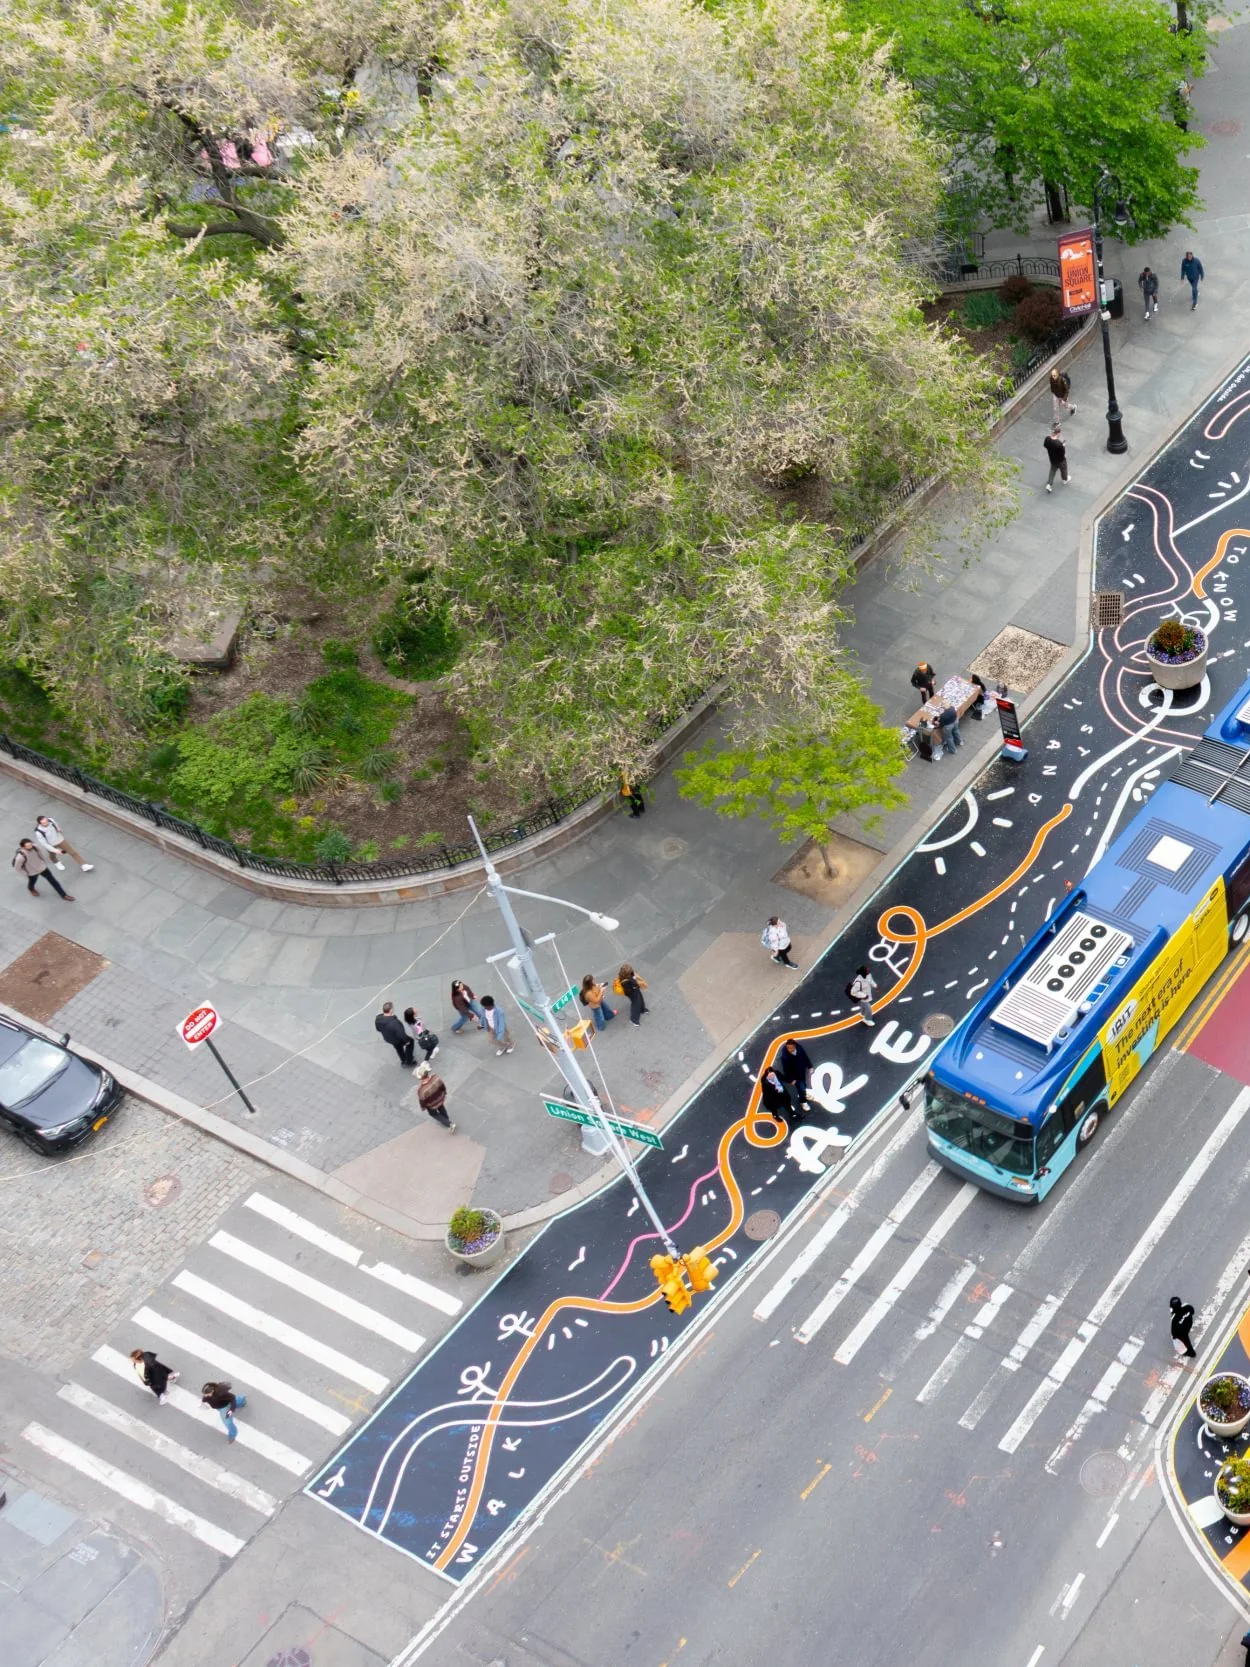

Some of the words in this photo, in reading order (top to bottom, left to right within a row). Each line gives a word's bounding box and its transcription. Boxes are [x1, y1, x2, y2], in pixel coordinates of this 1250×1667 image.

[1064, 273, 1092, 287] SQUARE
[1067, 266, 1089, 279] UNION
[1227, 545, 1248, 564] TO
[1212, 571, 1239, 622] KNOW
[185, 1021, 195, 1030] DO
[194, 1010, 207, 1022] NOT
[1111, 1005, 1132, 1038] IBIT
[1115, 1028, 1134, 1054] The
[1135, 996, 1157, 1028] next
[1157, 978, 1173, 1000] era
[1173, 958, 1184, 980] of
[193, 1021, 214, 1040] ENTER
[1116, 1010, 1161, 1069] investing
[1161, 996, 1171, 1013] is
[784, 1020, 932, 1174] ARE
[551, 1105, 585, 1121] Union
[587, 1115, 628, 1135] Sqare
[629, 1127, 659, 1145] West
[426, 1541, 442, 1559] IT
[440, 1487, 467, 1539] STARTS
[458, 1424, 481, 1483] OUTSIDE
[456, 1436, 526, 1563] WALK
